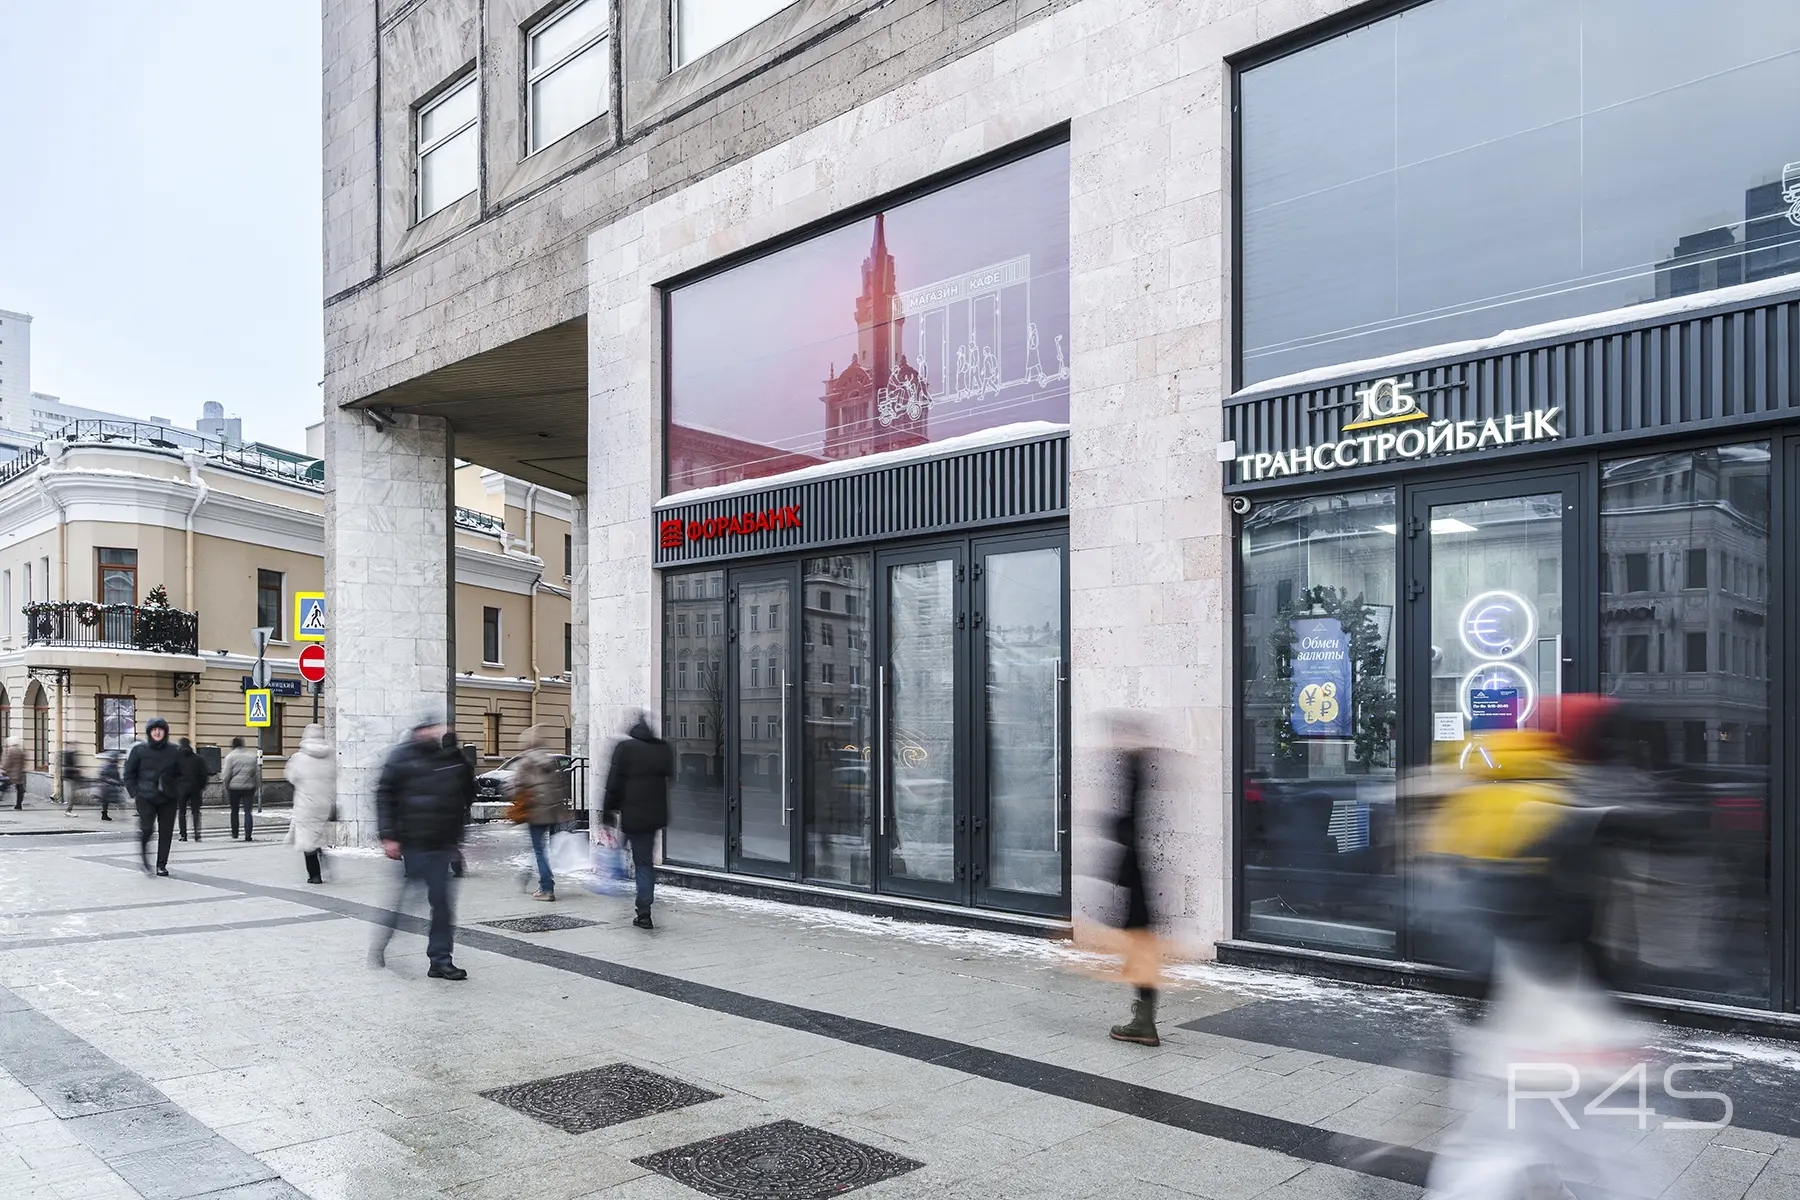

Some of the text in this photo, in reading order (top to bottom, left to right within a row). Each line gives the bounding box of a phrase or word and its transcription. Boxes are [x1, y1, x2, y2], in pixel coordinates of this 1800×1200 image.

[910, 272, 1000, 307] МАГАЗИН КАФЕ
[1237, 406, 1560, 481] ТРАНССТРОЙБАНК
[687, 505, 802, 542] ФОРАБАНК
[1297, 650, 1345, 661] валюты
[1302, 636, 1340, 650] Обмен
